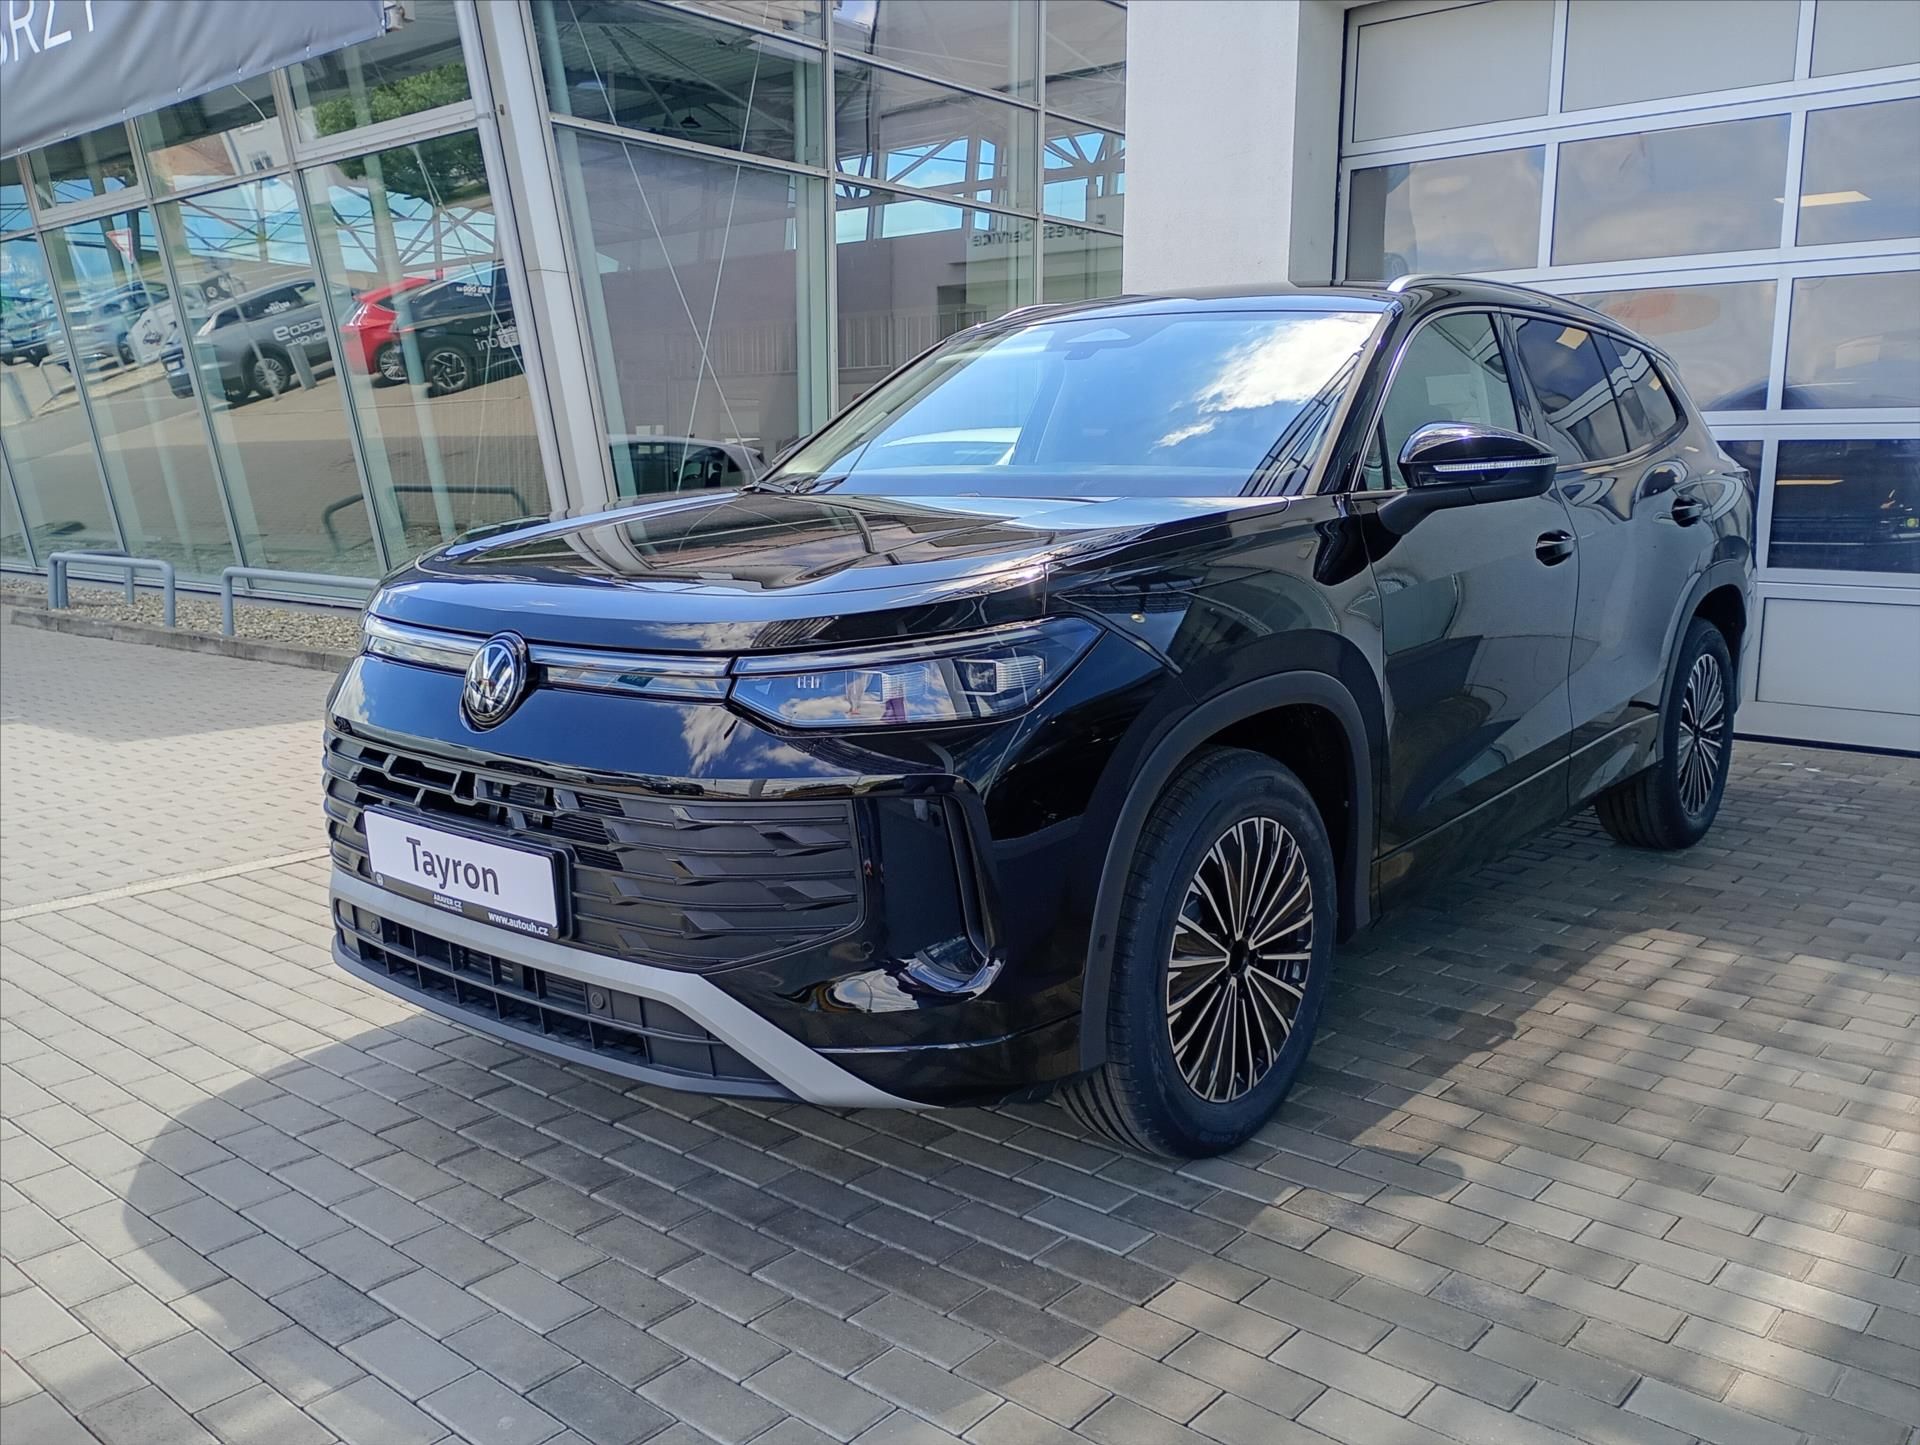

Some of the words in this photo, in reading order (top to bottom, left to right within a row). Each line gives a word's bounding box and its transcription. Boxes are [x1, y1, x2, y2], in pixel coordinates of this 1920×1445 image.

[0, 0, 94, 64] RZ
[406, 837, 499, 895] Tayron
[488, 911, 549, 936] www.autouh.cz
